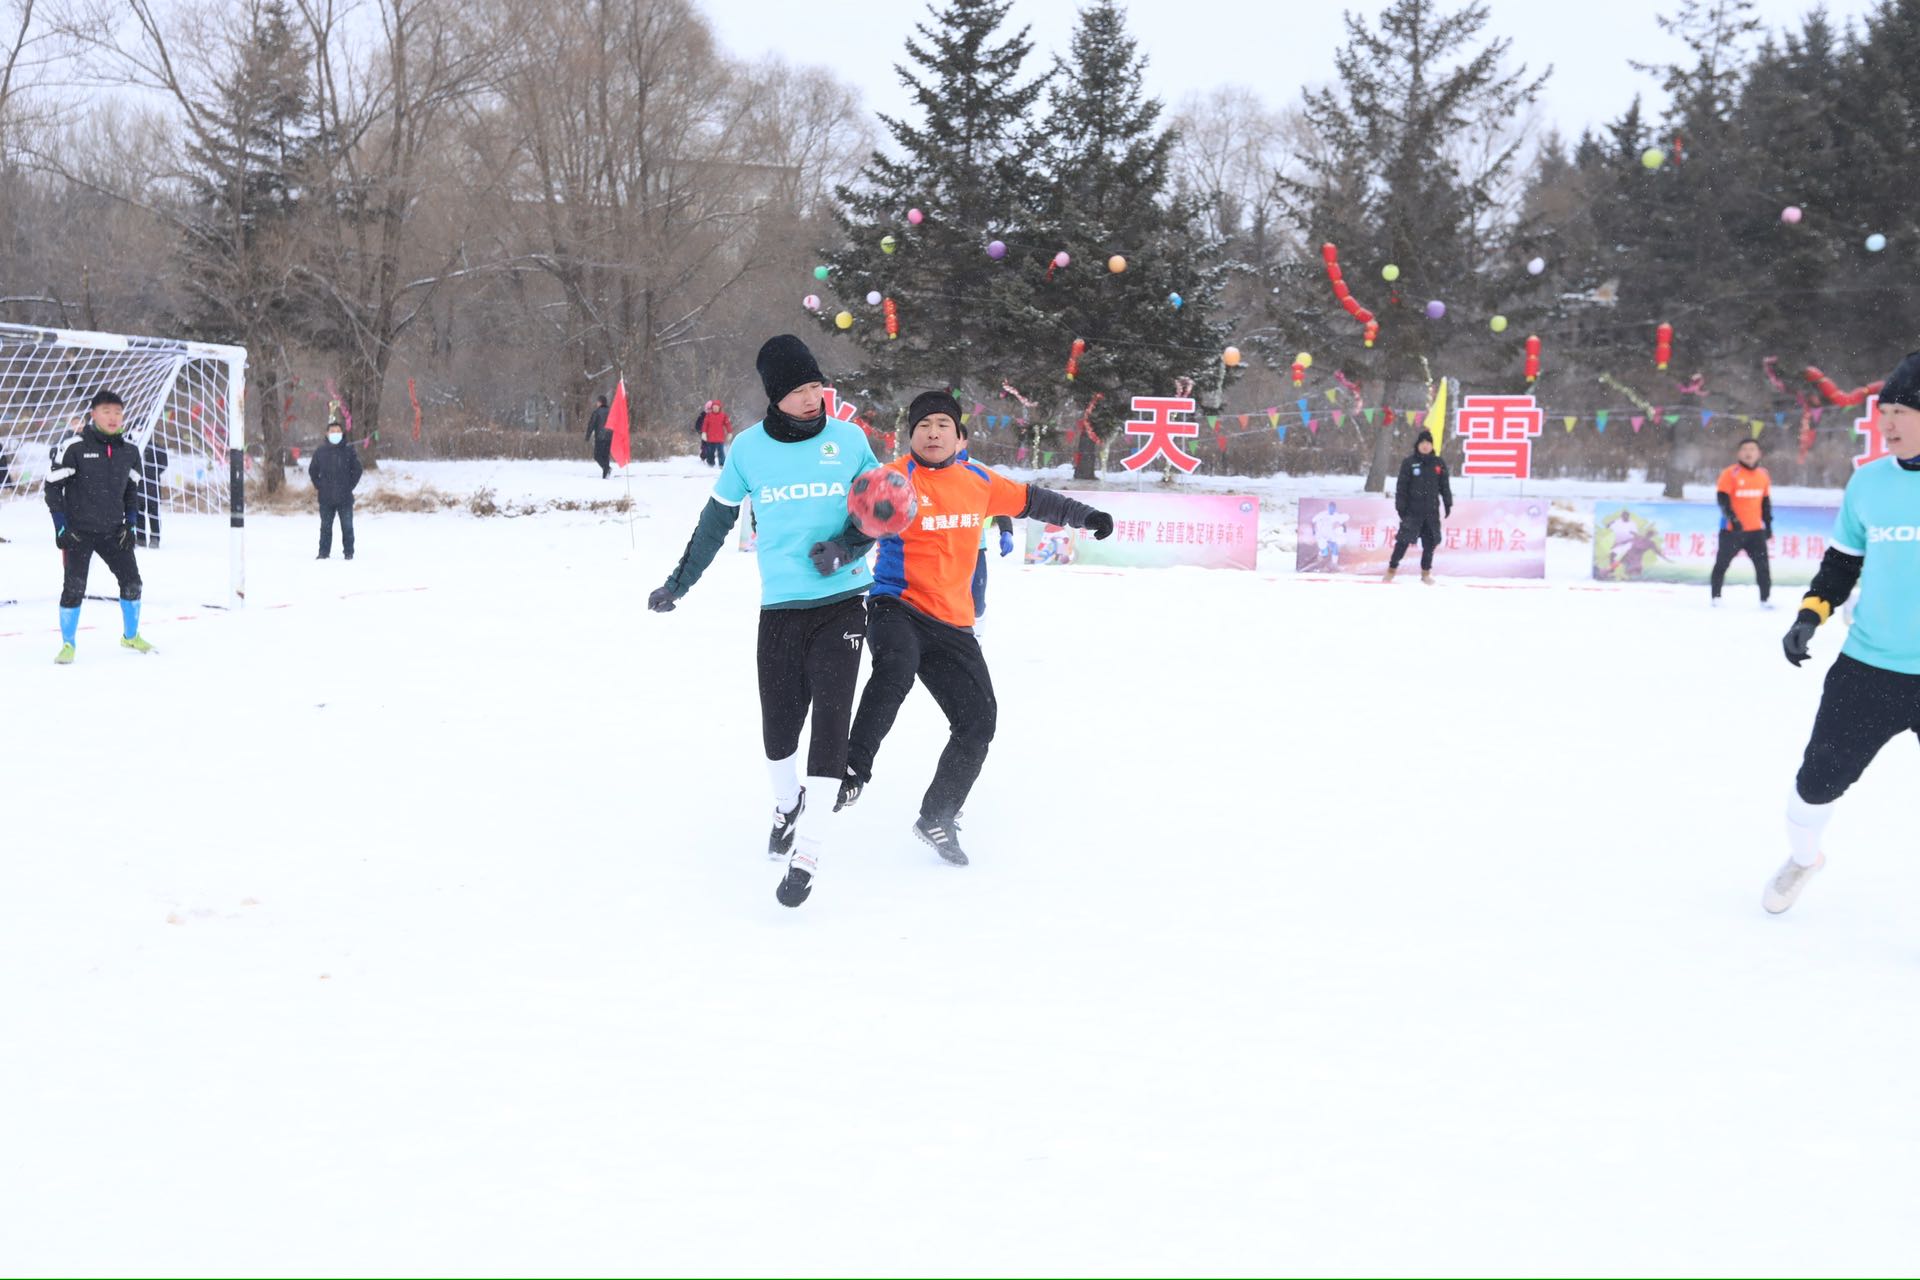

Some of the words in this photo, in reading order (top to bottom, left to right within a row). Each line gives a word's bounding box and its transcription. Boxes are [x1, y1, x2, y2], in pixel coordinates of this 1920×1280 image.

[1120, 396, 1201, 474] 天
[1456, 395, 1542, 479] 雪
[1359, 526, 1526, 551] 黑龙足球协会
